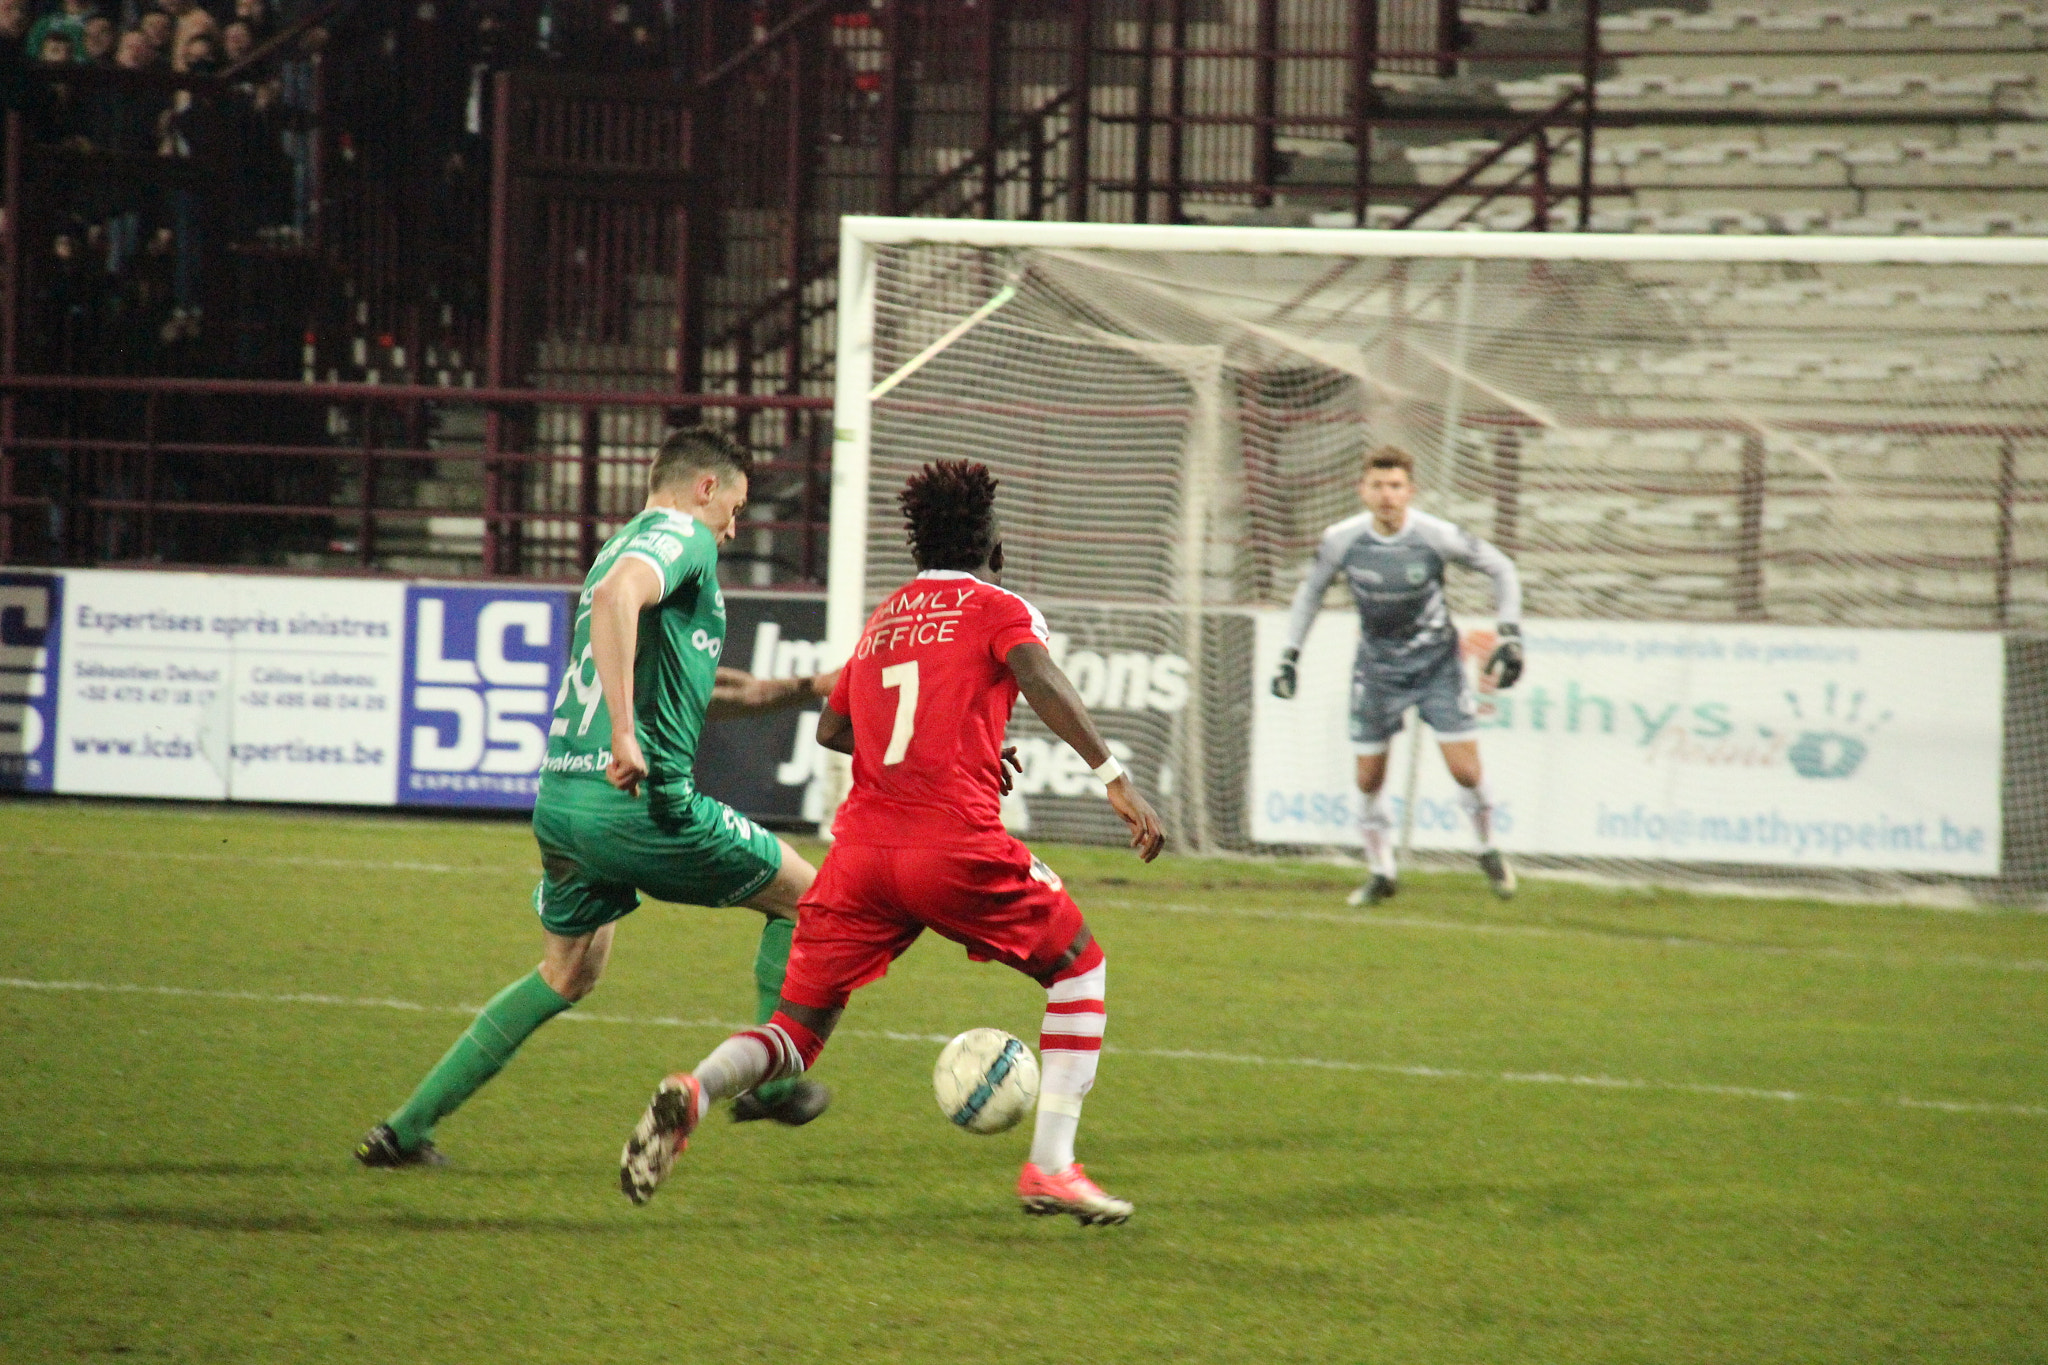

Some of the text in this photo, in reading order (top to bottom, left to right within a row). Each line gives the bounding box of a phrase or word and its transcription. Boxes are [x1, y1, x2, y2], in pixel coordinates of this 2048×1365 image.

[76, 605, 390, 639] Expertises après sinistres
[416, 598, 552, 686] LC
[857, 620, 959, 660] OFFICE
[412, 687, 549, 775] DS
[881, 660, 920, 766] 7
[1474, 679, 1733, 746] athys
